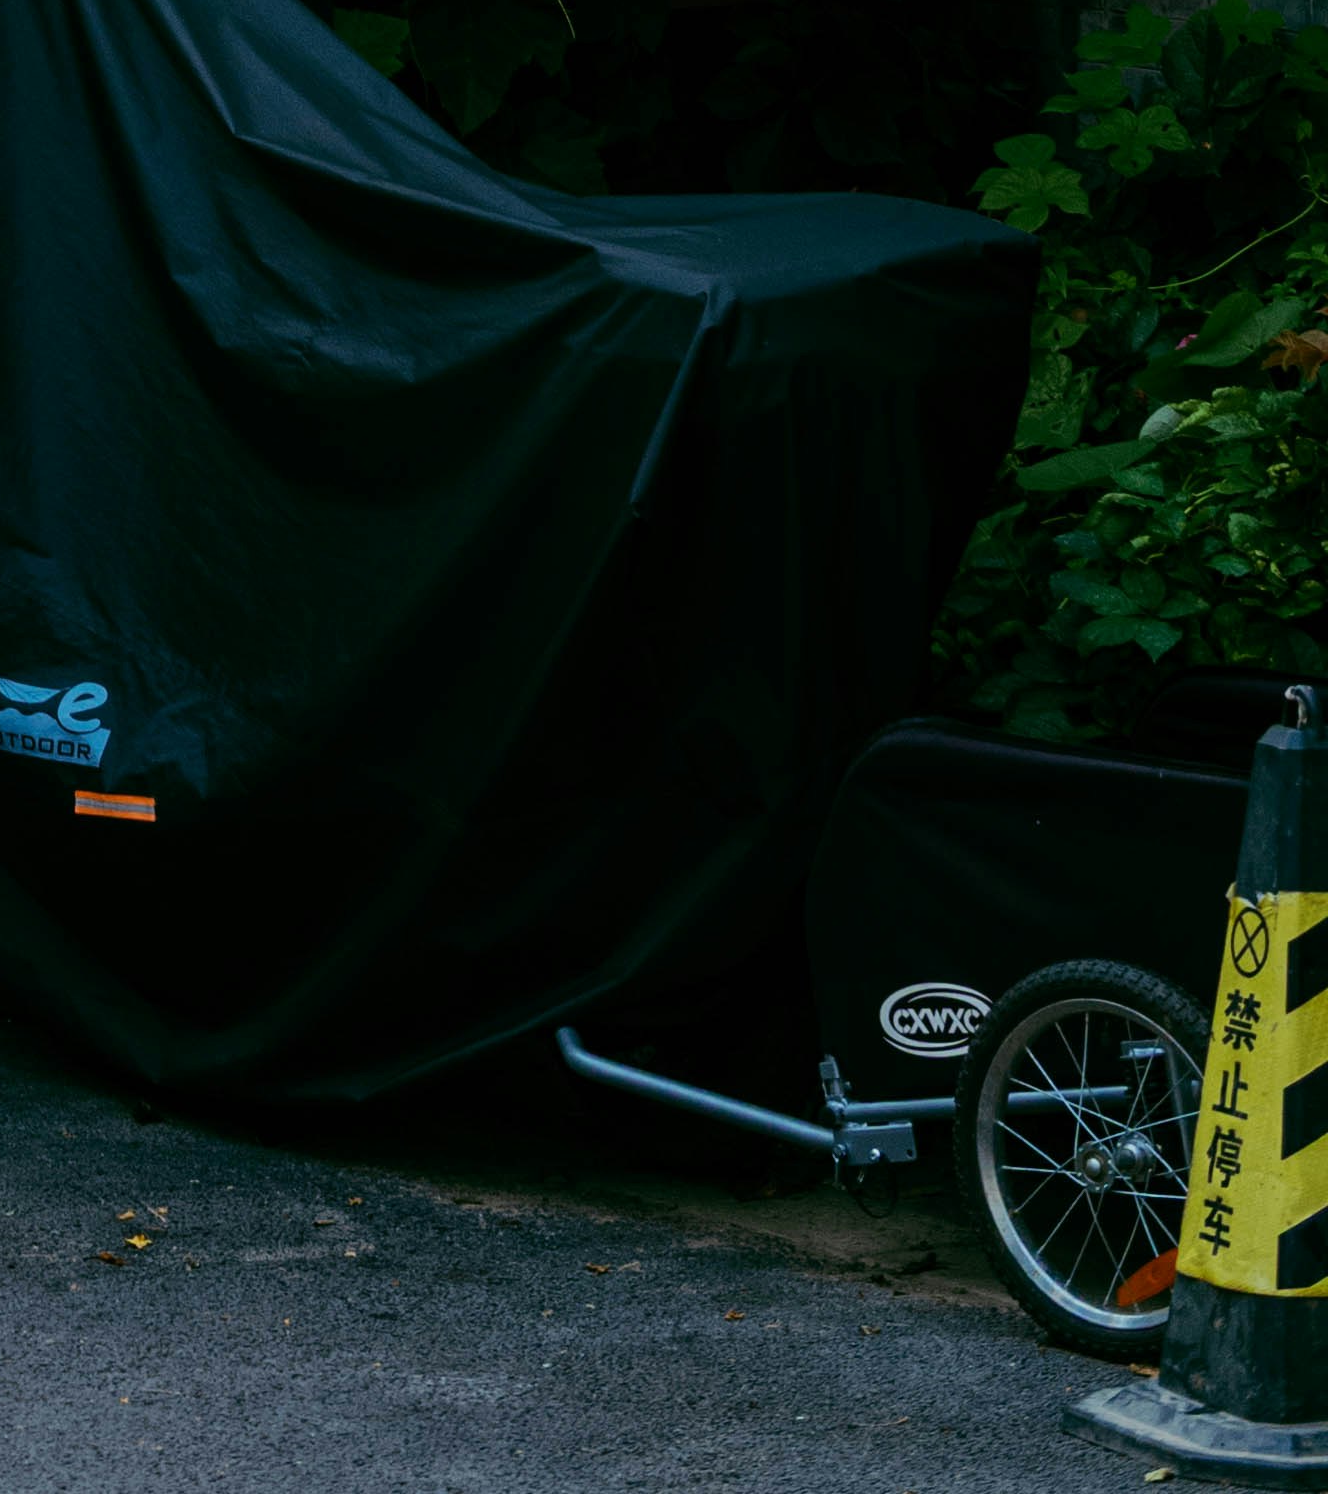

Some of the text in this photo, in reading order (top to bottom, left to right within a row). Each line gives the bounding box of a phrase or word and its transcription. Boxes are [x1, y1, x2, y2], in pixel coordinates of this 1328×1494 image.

[892, 1007, 982, 1035] CXWXC
[1198, 988, 1262, 1257] 禁止停车
